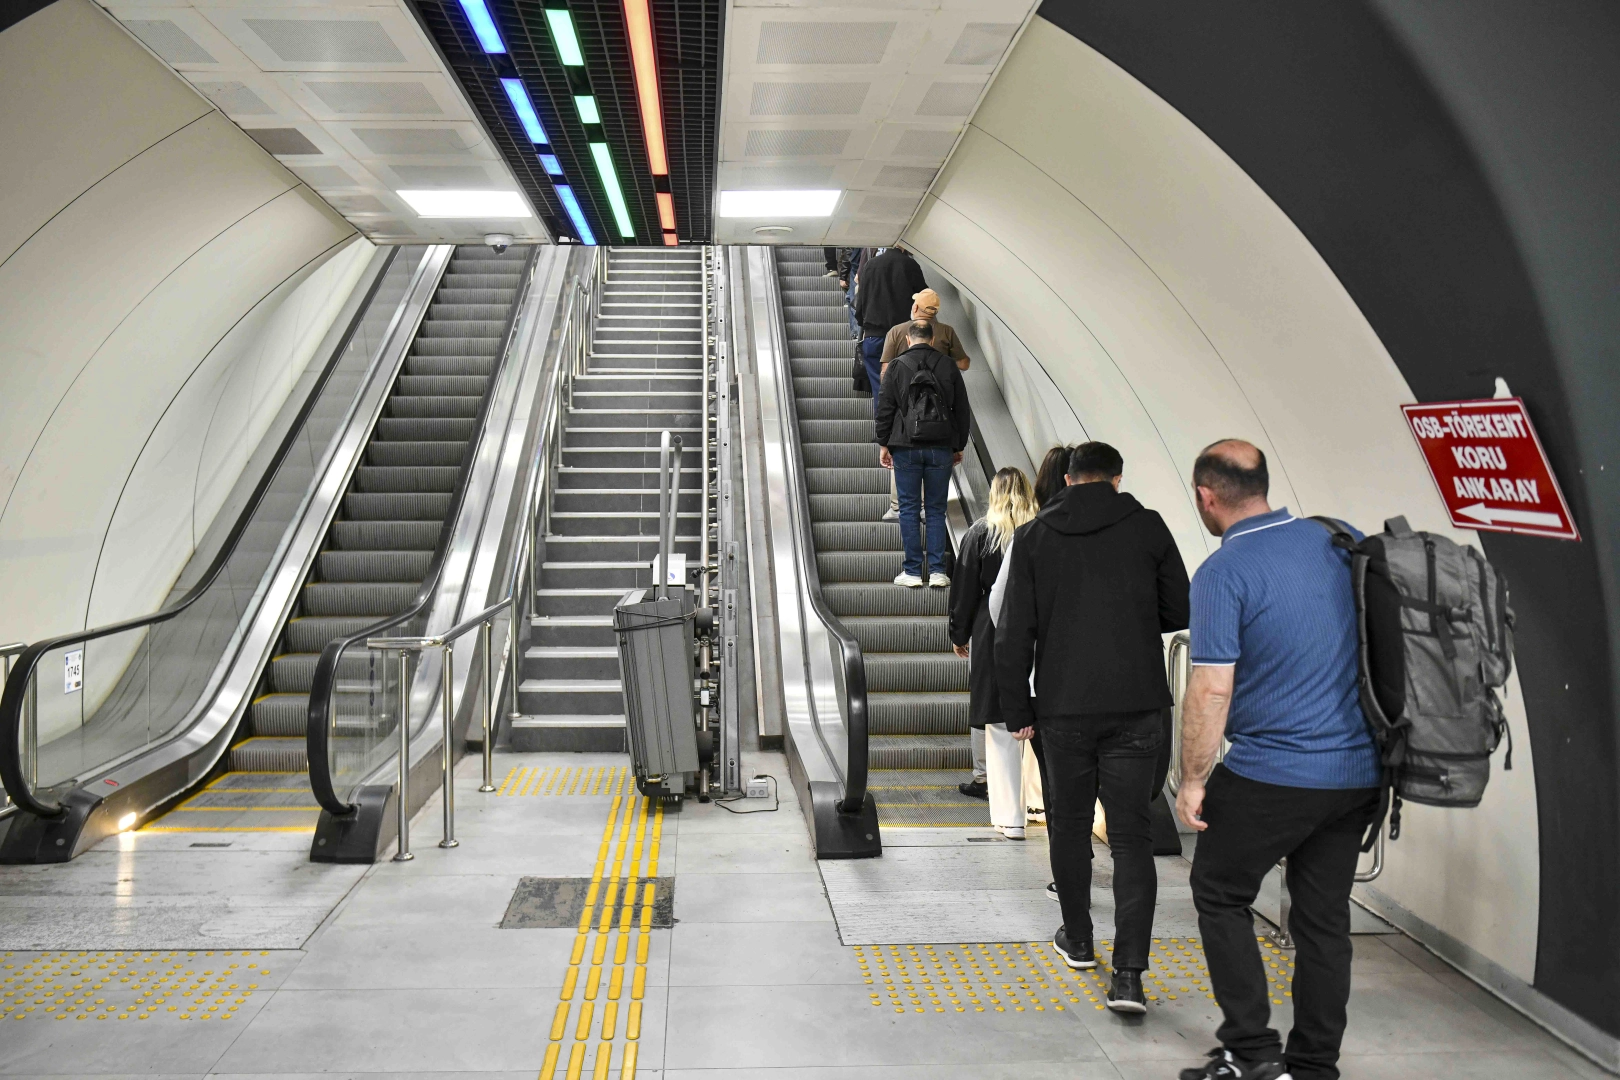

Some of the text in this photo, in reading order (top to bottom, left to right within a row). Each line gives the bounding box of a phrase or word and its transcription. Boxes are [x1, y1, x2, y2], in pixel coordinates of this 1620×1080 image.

[1412, 411, 1527, 438] OSB-TÖREKENT
[1451, 446, 1507, 470] KORU
[1453, 476, 1541, 504] ANKARAY
[67, 664, 80, 678] 1745
